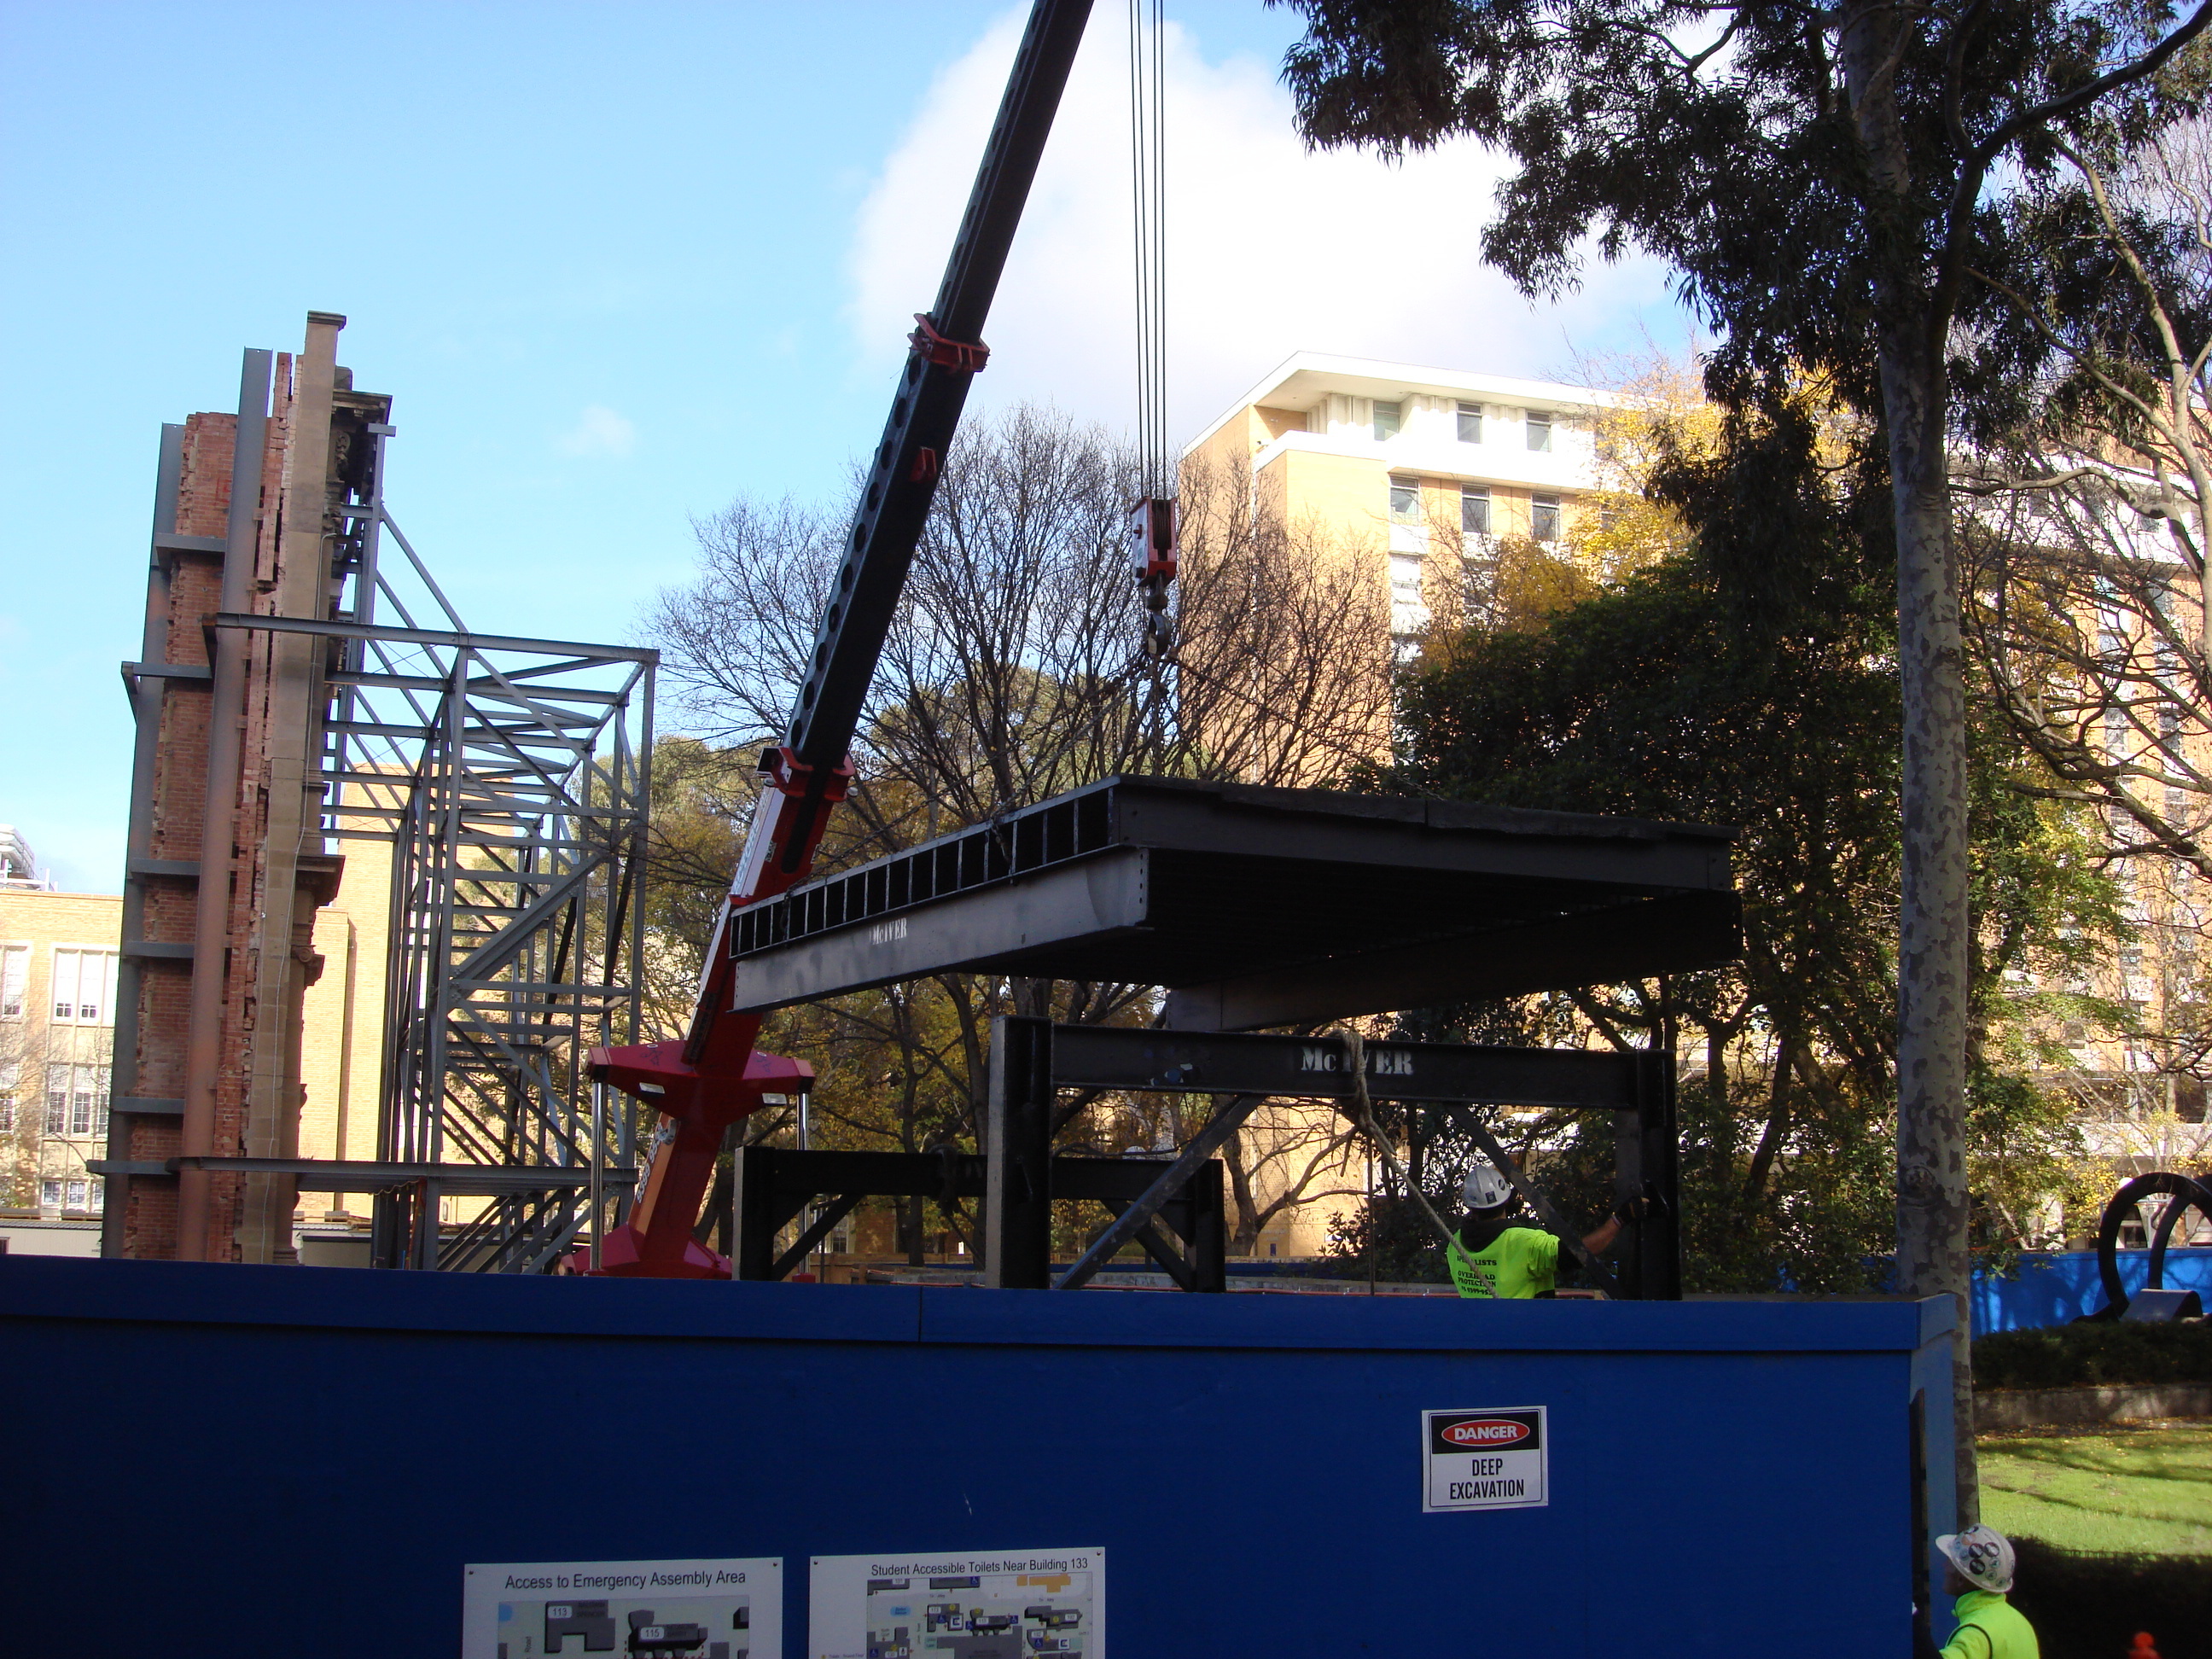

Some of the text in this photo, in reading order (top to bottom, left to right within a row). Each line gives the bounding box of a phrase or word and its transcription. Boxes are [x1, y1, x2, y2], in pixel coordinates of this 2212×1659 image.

[872, 917, 907, 945] McIVER
[1301, 1047, 1414, 1075] McIER
[1458, 1270, 1495, 1280] OVERHAD
[1454, 1425, 1518, 1441] DANGER
[1472, 1458, 1503, 1476] DEEP
[1450, 1479, 1524, 1499] EXCAVATION
[871, 1557, 1088, 1576] Student Accessible Toilets Near Building 133
[505, 1570, 746, 1590] Access to Emergency Assembly Area
[553, 1608, 568, 1616] 113
[645, 1628, 660, 1638] 115
